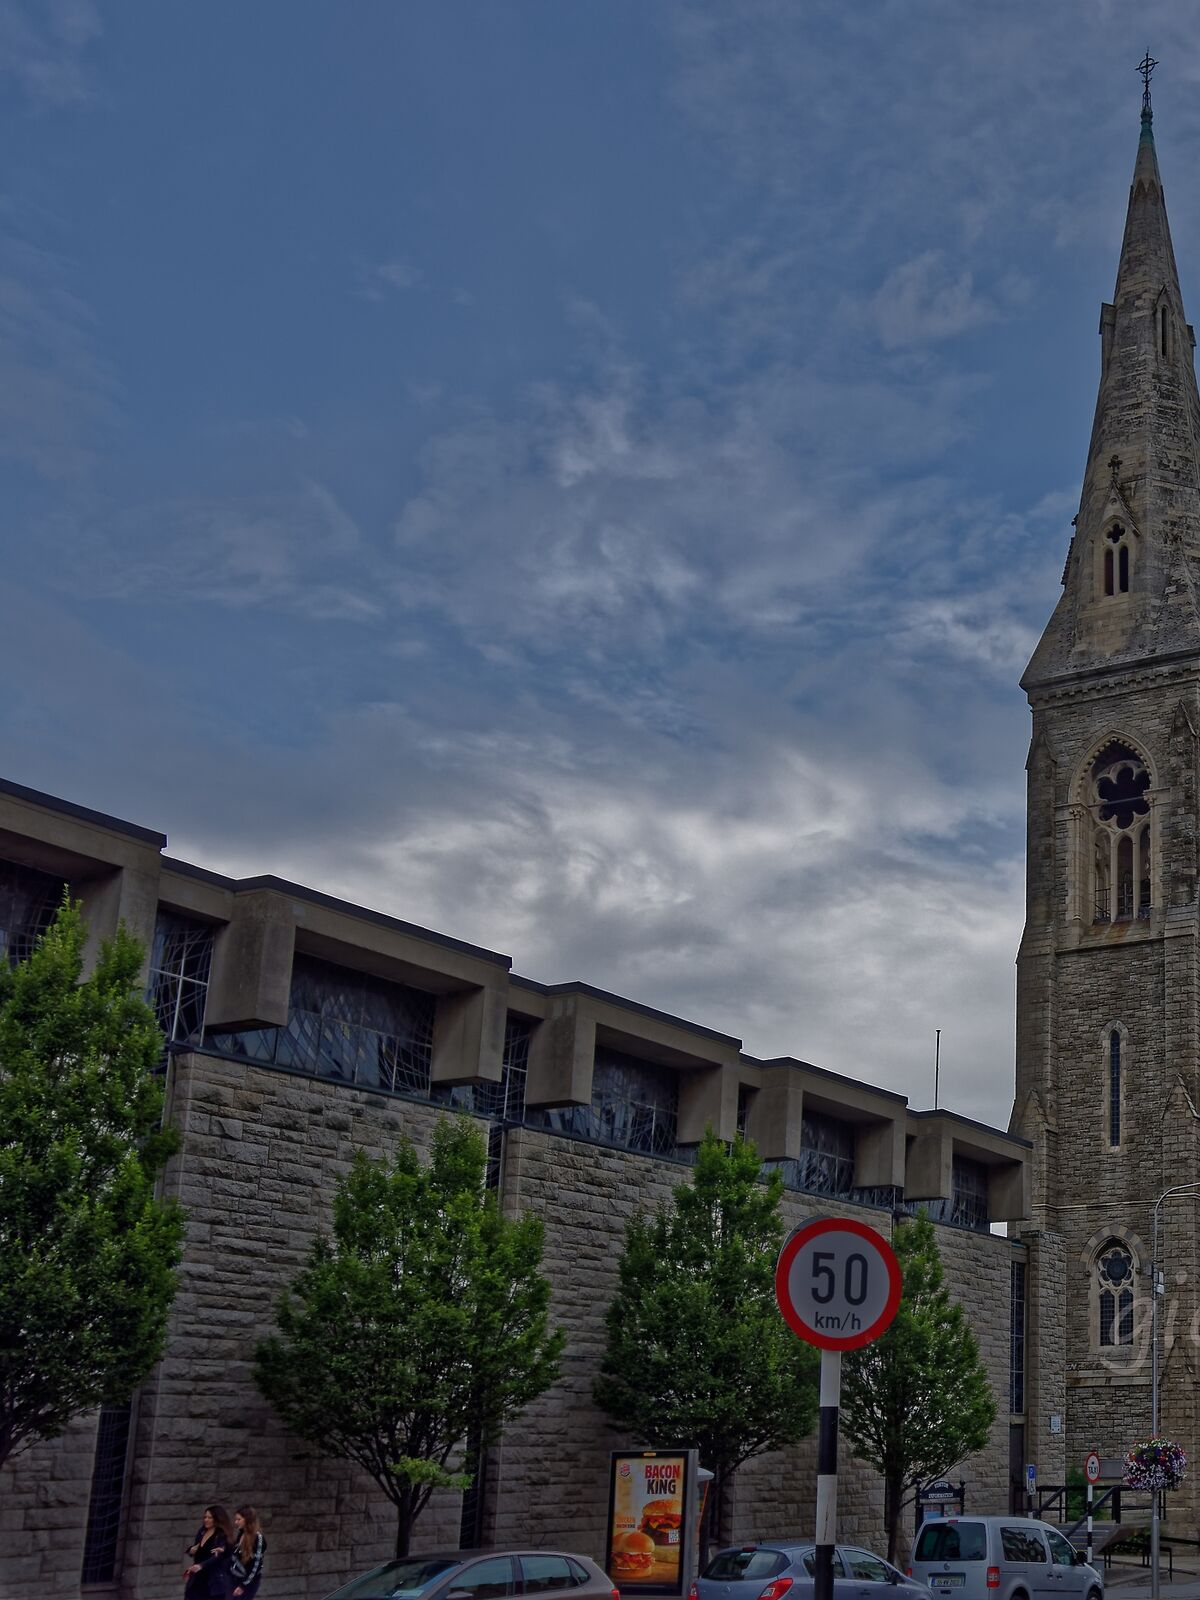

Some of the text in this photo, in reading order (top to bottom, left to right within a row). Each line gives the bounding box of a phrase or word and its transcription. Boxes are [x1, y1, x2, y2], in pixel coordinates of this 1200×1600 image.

[811, 1252, 868, 1306] 50
[815, 1311, 861, 1331] km/h
[645, 1464, 680, 1479] BACON
[647, 1479, 676, 1495] KING
